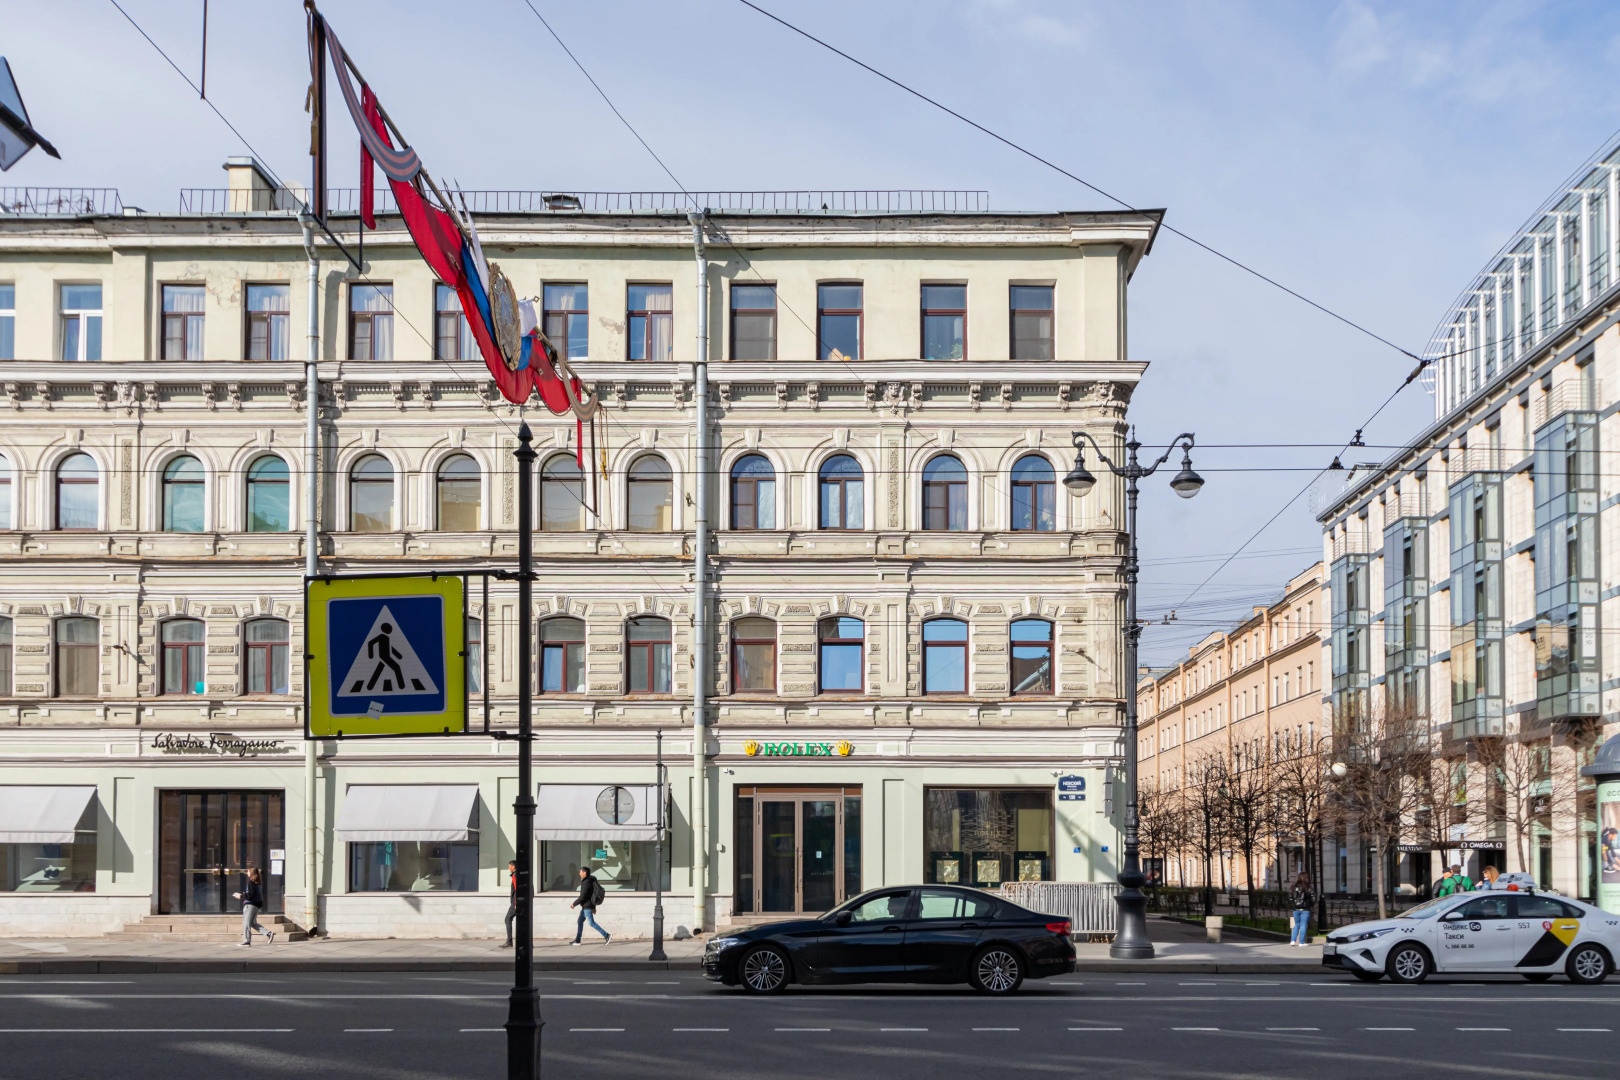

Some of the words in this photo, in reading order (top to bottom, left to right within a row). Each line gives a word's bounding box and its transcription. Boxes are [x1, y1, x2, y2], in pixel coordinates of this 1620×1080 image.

[151, 733, 208, 749] Salvatore
[210, 732, 285, 757] Ferragamo
[763, 742, 833, 756] ROLEX
[1442, 923, 1468, 931] Яндекс
[1444, 932, 1465, 940] Такси
